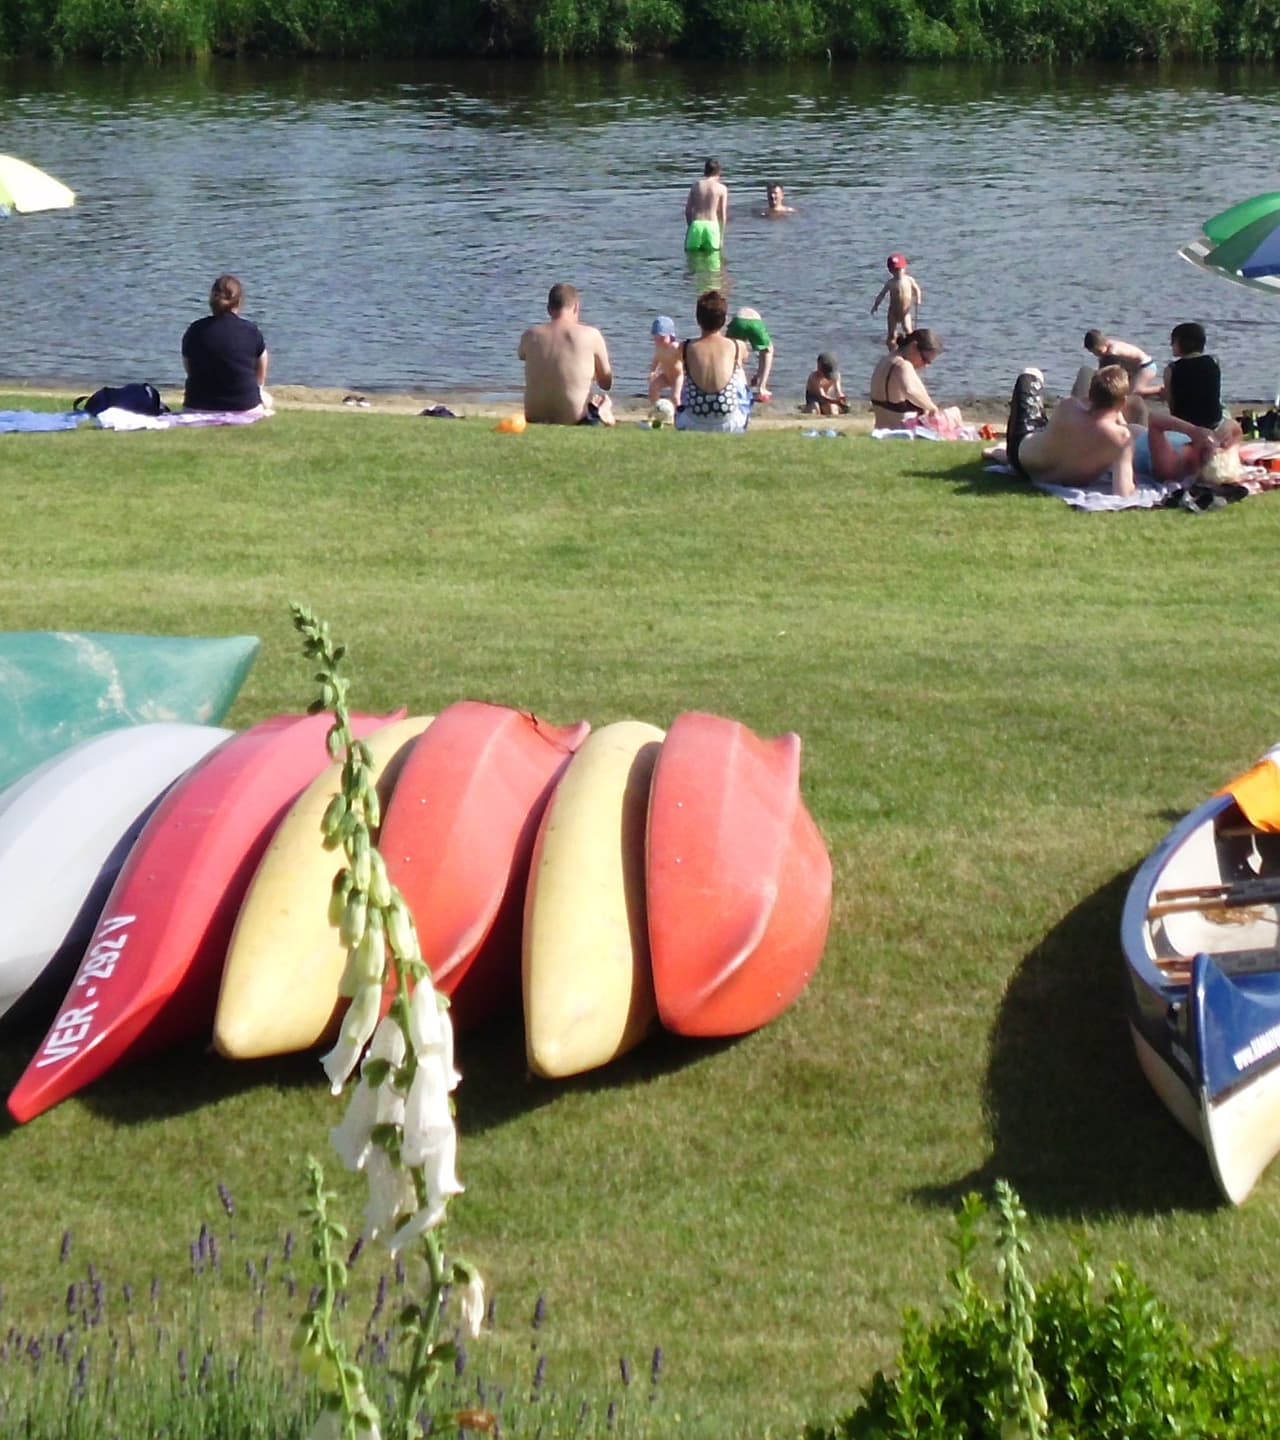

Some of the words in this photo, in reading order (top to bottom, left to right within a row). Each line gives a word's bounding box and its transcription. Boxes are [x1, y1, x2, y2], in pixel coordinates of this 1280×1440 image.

[98, 914, 137, 940] V
[77, 933, 129, 987] 292
[36, 1001, 100, 1068] VER
